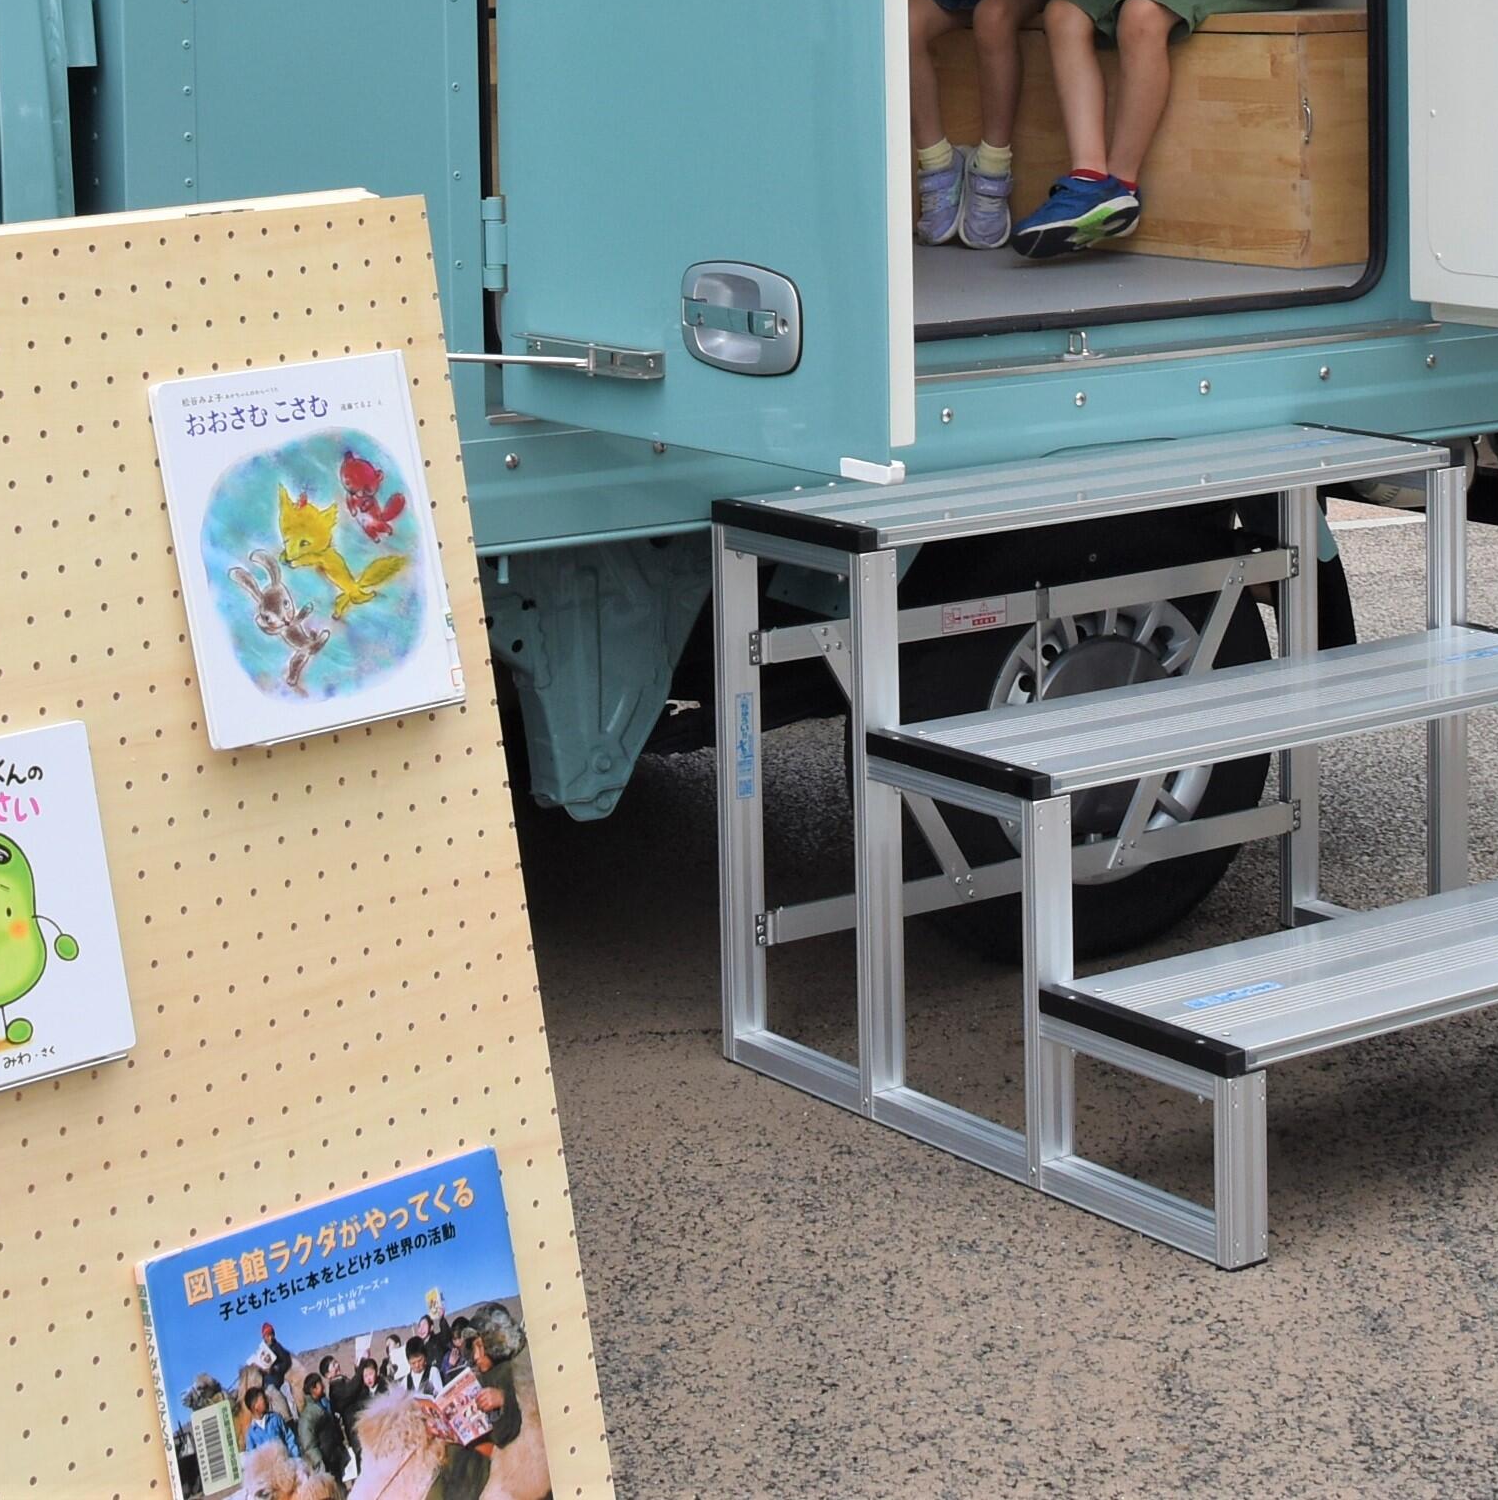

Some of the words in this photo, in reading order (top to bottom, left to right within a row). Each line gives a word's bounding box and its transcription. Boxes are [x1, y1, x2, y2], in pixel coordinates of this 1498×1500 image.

[185, 404, 268, 437] おおさむ
[275, 395, 329, 423] こさむ
[183, 1177, 476, 1307] 図書館ラクダがやってくる
[219, 1221, 457, 1322] 子どもたちに本をとどける世界の活動
